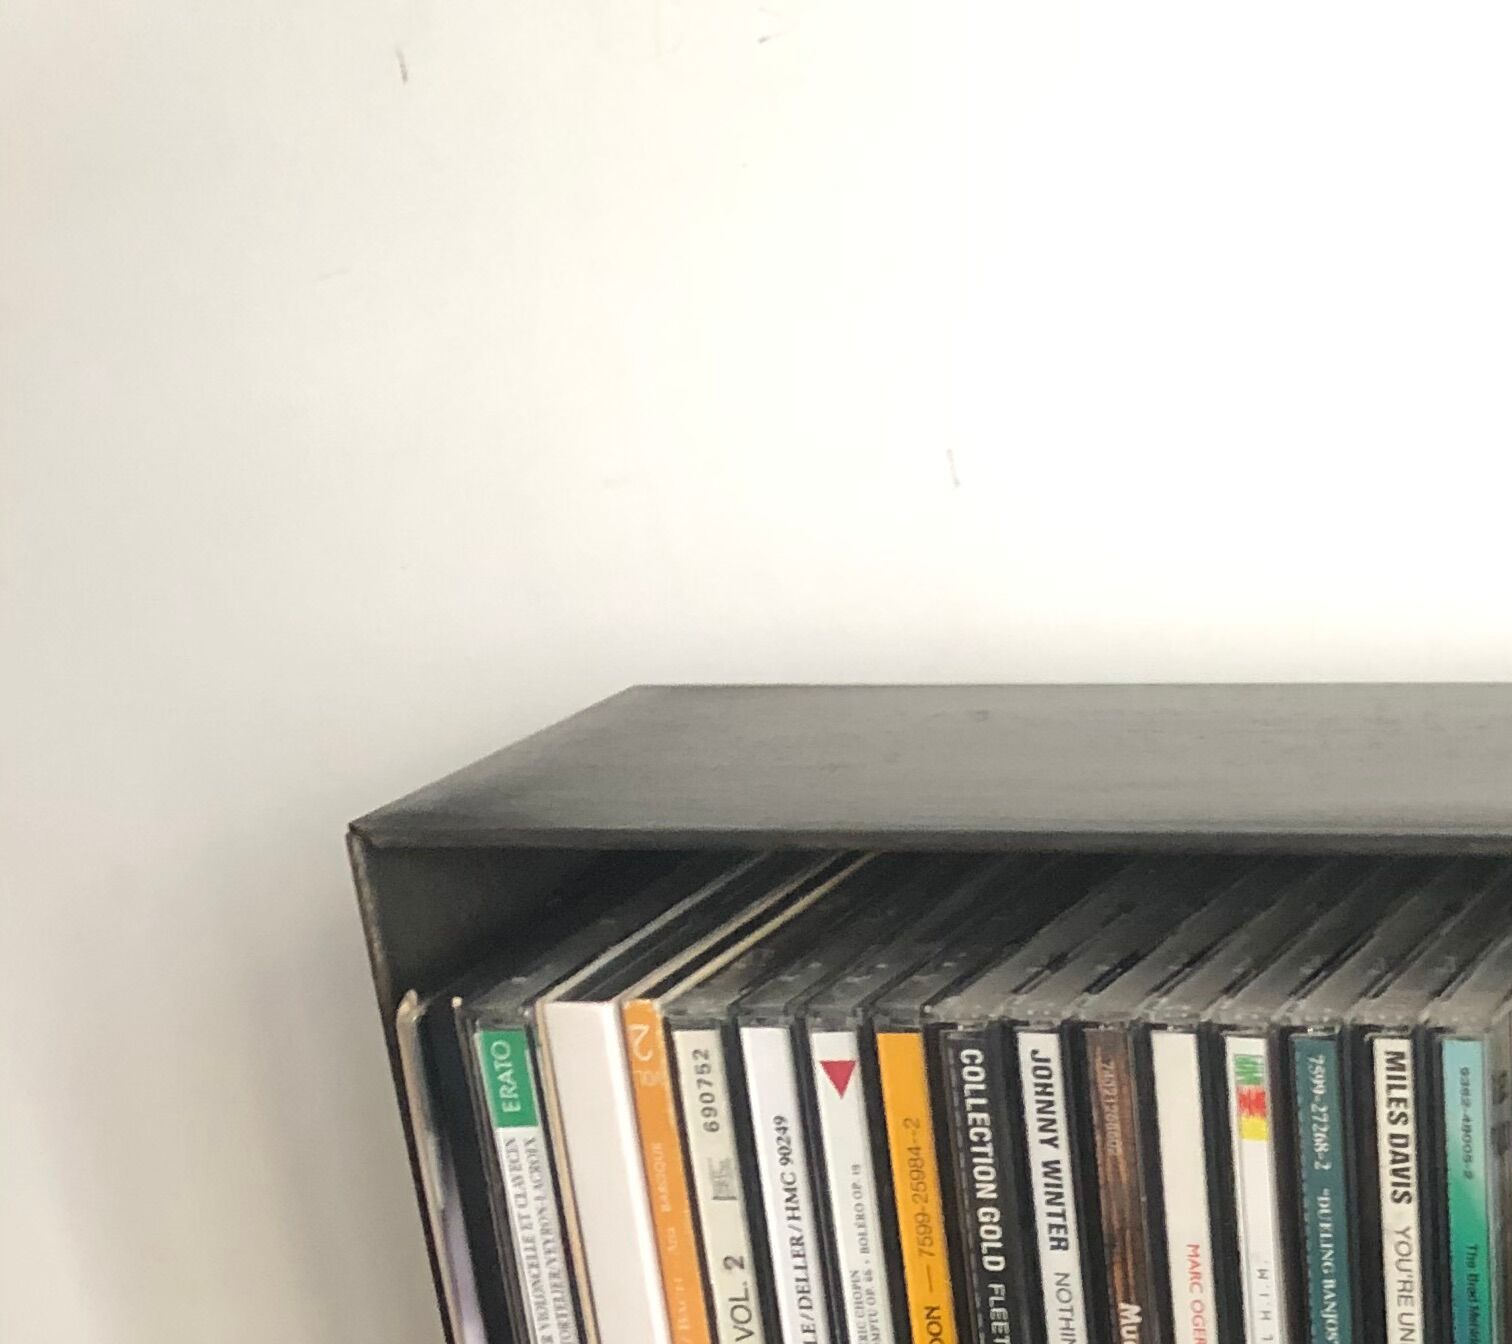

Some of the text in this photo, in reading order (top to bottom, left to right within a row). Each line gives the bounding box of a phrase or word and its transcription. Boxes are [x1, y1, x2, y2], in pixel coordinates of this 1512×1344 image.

[490, 1039, 522, 1113] ERATO
[691, 1047, 721, 1133] 690752
[1029, 1048, 1060, 1150] JOHNNY
[1383, 1050, 1410, 1126] MILES
[772, 1114, 795, 1167] 90249
[960, 1048, 998, 1200] COLLECTION
[1388, 1131, 1413, 1206] DAVIS
[851, 1205, 871, 1256] BOLÉRO
[977, 1206, 1007, 1272] GOLD
[1040, 1159, 1070, 1252] WINTER
[722, 1254, 746, 1271] 2
[1185, 1243, 1204, 1295] MARC
[1392, 1225, 1416, 1308] YOU'RE
[1464, 1243, 1479, 1270] The
[727, 1281, 755, 1343] VOL.
[849, 1269, 865, 1320] CHOPIN
